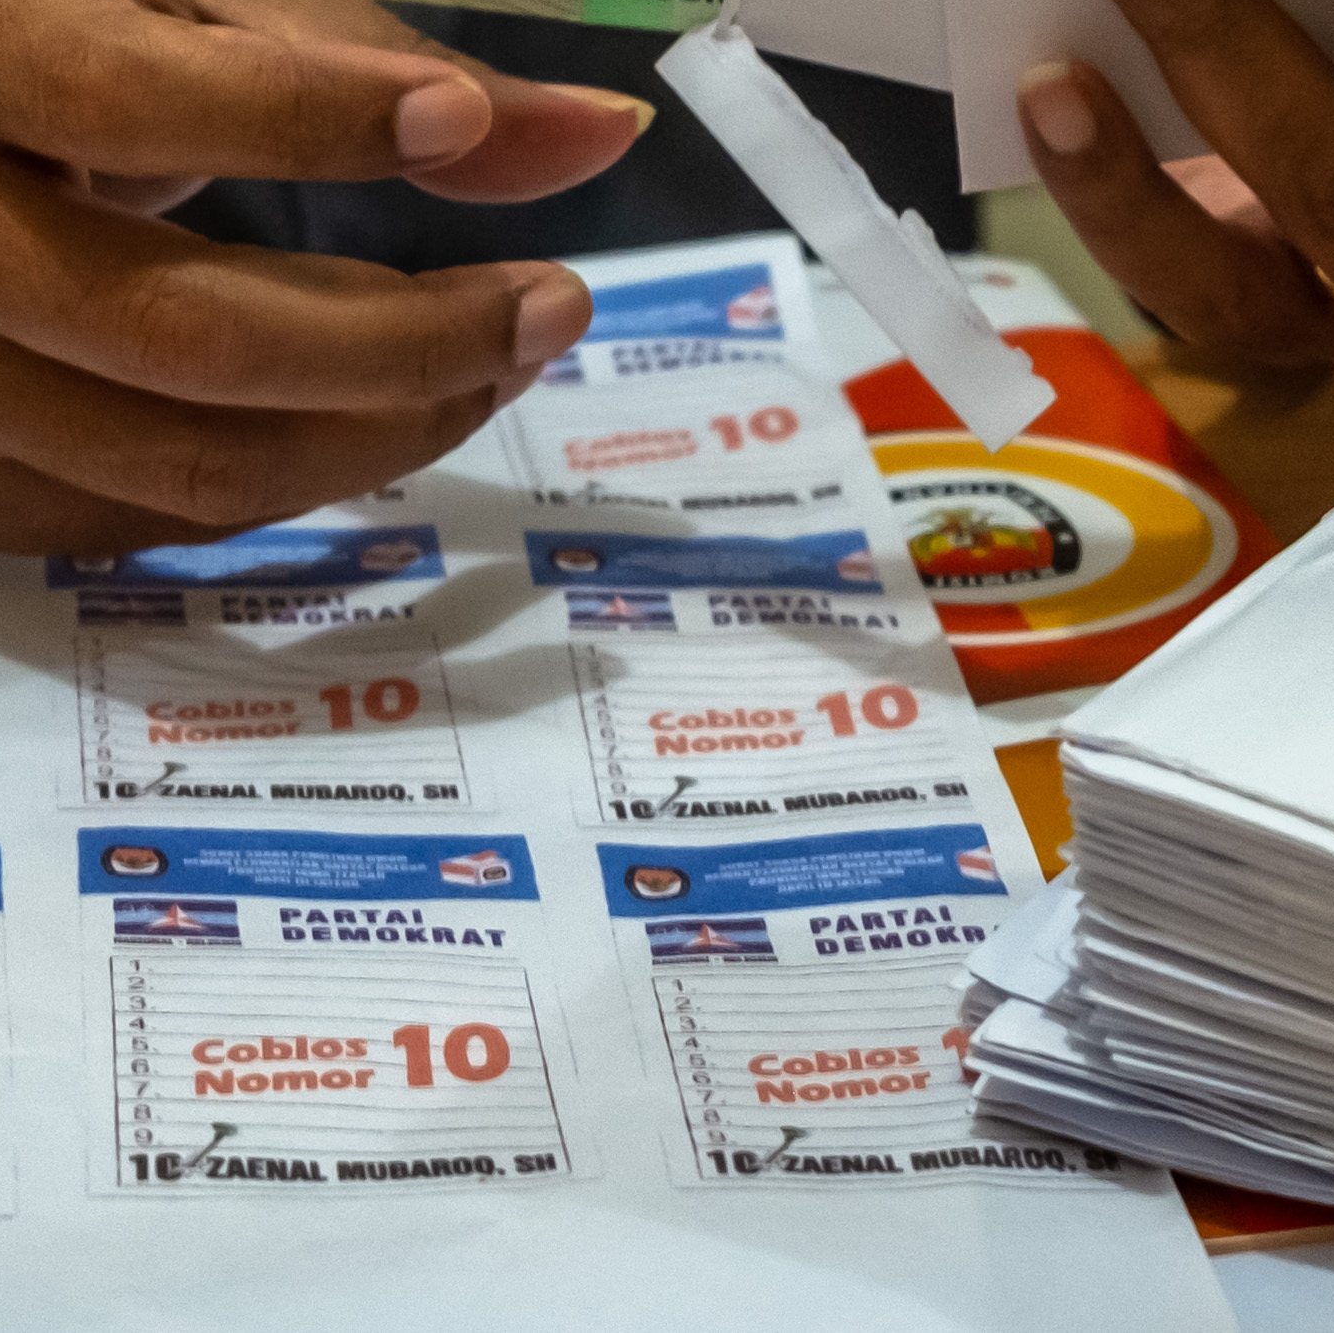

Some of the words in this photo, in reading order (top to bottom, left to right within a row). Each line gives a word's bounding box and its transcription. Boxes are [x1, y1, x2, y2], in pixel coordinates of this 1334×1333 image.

[146, 700, 296, 720] Coblos
[318, 678, 421, 729] 10
[816, 684, 919, 738] 10
[147, 720, 302, 744] Nomor
[648, 709, 798, 732] Coblos
[654, 730, 806, 758] Nomor
[159, 783, 263, 800] ZAENAL
[422, 783, 460, 801] SH
[672, 798, 776, 819] ZAENAL
[279, 907, 424, 924] PARTAI
[809, 905, 953, 935] PARTAI
[282, 926, 506, 947] DEMOKRAT
[814, 924, 1000, 956] DEMOKR
[191, 1036, 368, 1065] Coblos
[392, 1022, 511, 1088] 10
[748, 1045, 921, 1076] Coblos
[942, 1027, 980, 1084] 1
[194, 1068, 375, 1097] Nomor
[754, 1071, 931, 1105] Nomor
[205, 1156, 327, 1182] ZAENAL
[338, 1155, 506, 1182] MUBAROQ,
[516, 1152, 557, 1173] SH
[783, 1154, 904, 1173] ZAENAL
[909, 1145, 1077, 1173] MUBAROQ,
